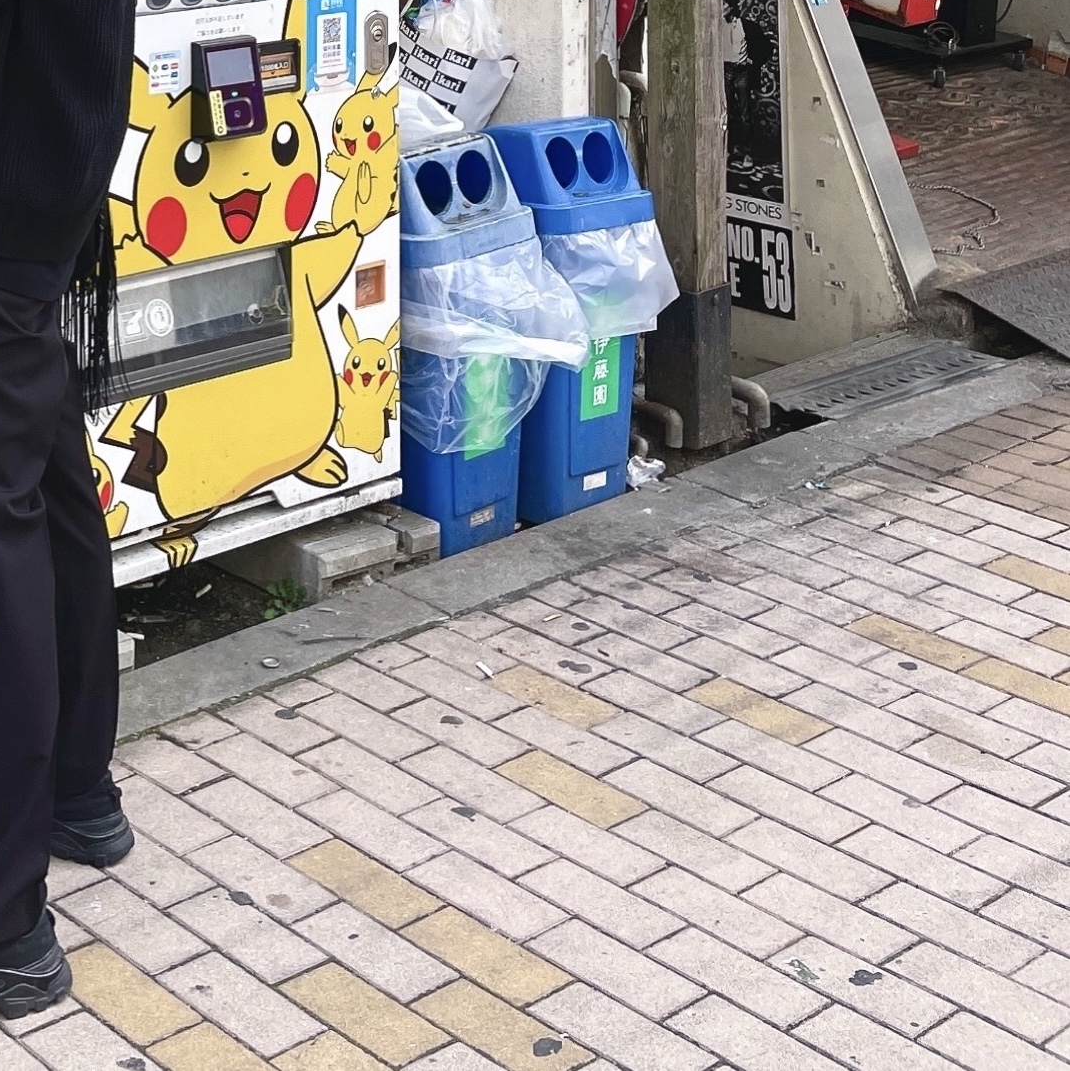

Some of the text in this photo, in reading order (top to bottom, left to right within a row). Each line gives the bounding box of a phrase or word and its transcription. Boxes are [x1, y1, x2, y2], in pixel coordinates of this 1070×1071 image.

[412, 46, 441, 69] ikari
[446, 50, 471, 69] ikari
[402, 69, 428, 90] ikari
[434, 73, 461, 92] ikari
[736, 198, 782, 220] STONES
[727, 222, 760, 264] NO.
[761, 228, 792, 313] 53
